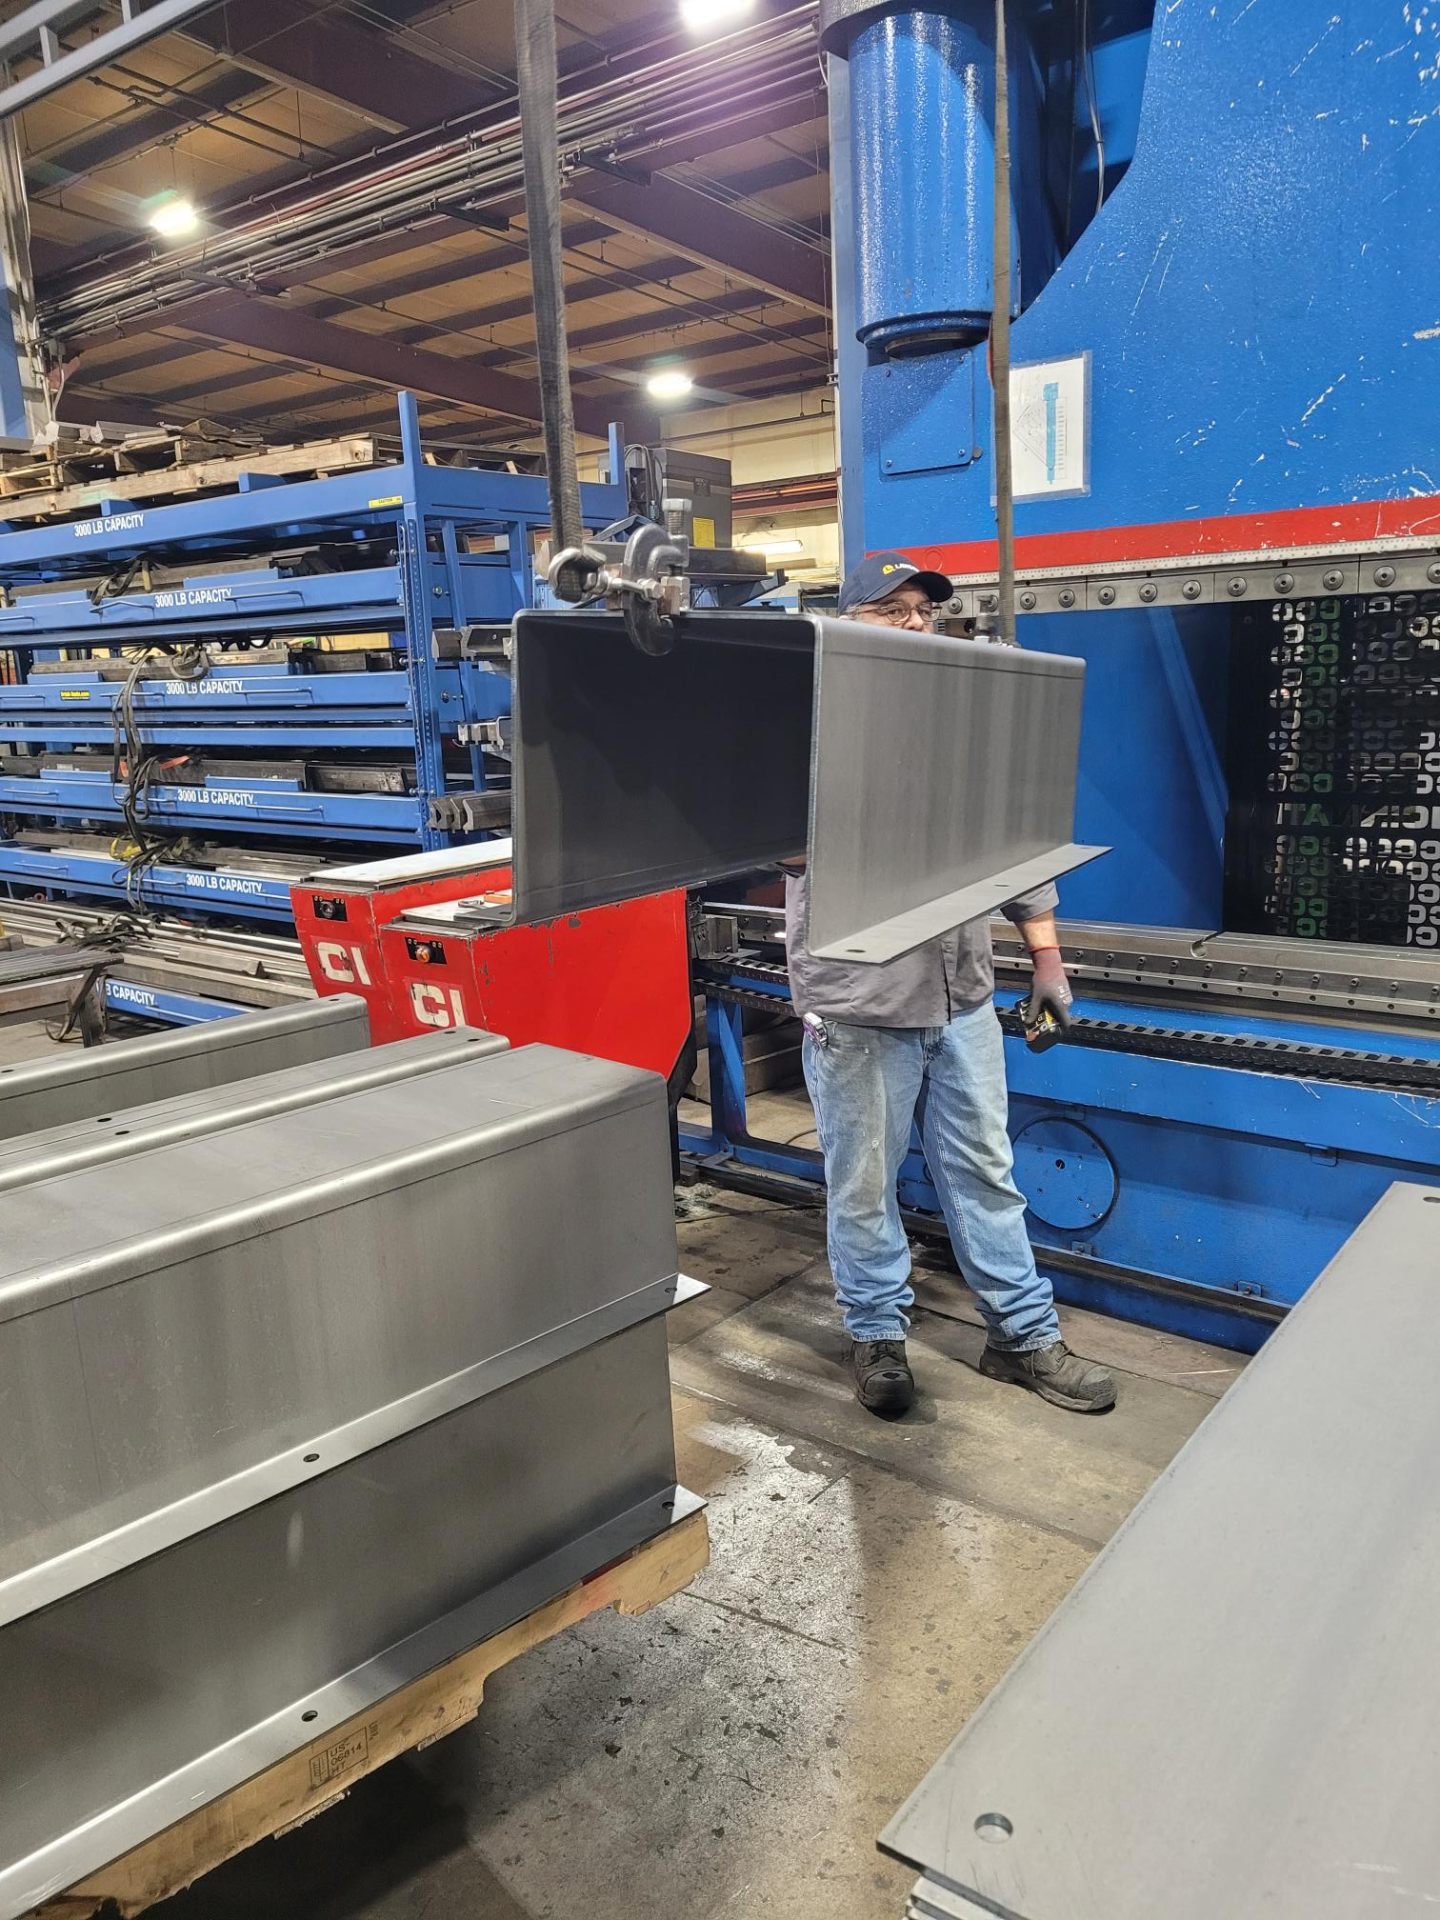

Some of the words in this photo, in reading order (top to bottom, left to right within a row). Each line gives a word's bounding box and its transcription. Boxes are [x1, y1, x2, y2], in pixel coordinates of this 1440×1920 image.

[74, 523, 92, 537] 3000
[92, 520, 104, 534] LB
[104, 514, 144, 533] CAPACITY
[154, 594, 174, 608] 3000
[175, 592, 187, 606] LB
[188, 588, 232, 605] CAPACITY
[166, 682, 185, 695] 3000
[186, 682, 198, 694] LB
[199, 681, 243, 694] CAPACITY
[177, 789, 197, 802] 3000
[197, 790, 209, 803] LB
[210, 792, 254, 806] CAPACITY
[186, 874, 205, 888] 3000
[205, 876, 218, 889] LB
[219, 878, 262, 894] CAPACITY
[317, 941, 372, 986] CI
[112, 984, 155, 1005] CAPACITY
[410, 983, 466, 1028] CI
